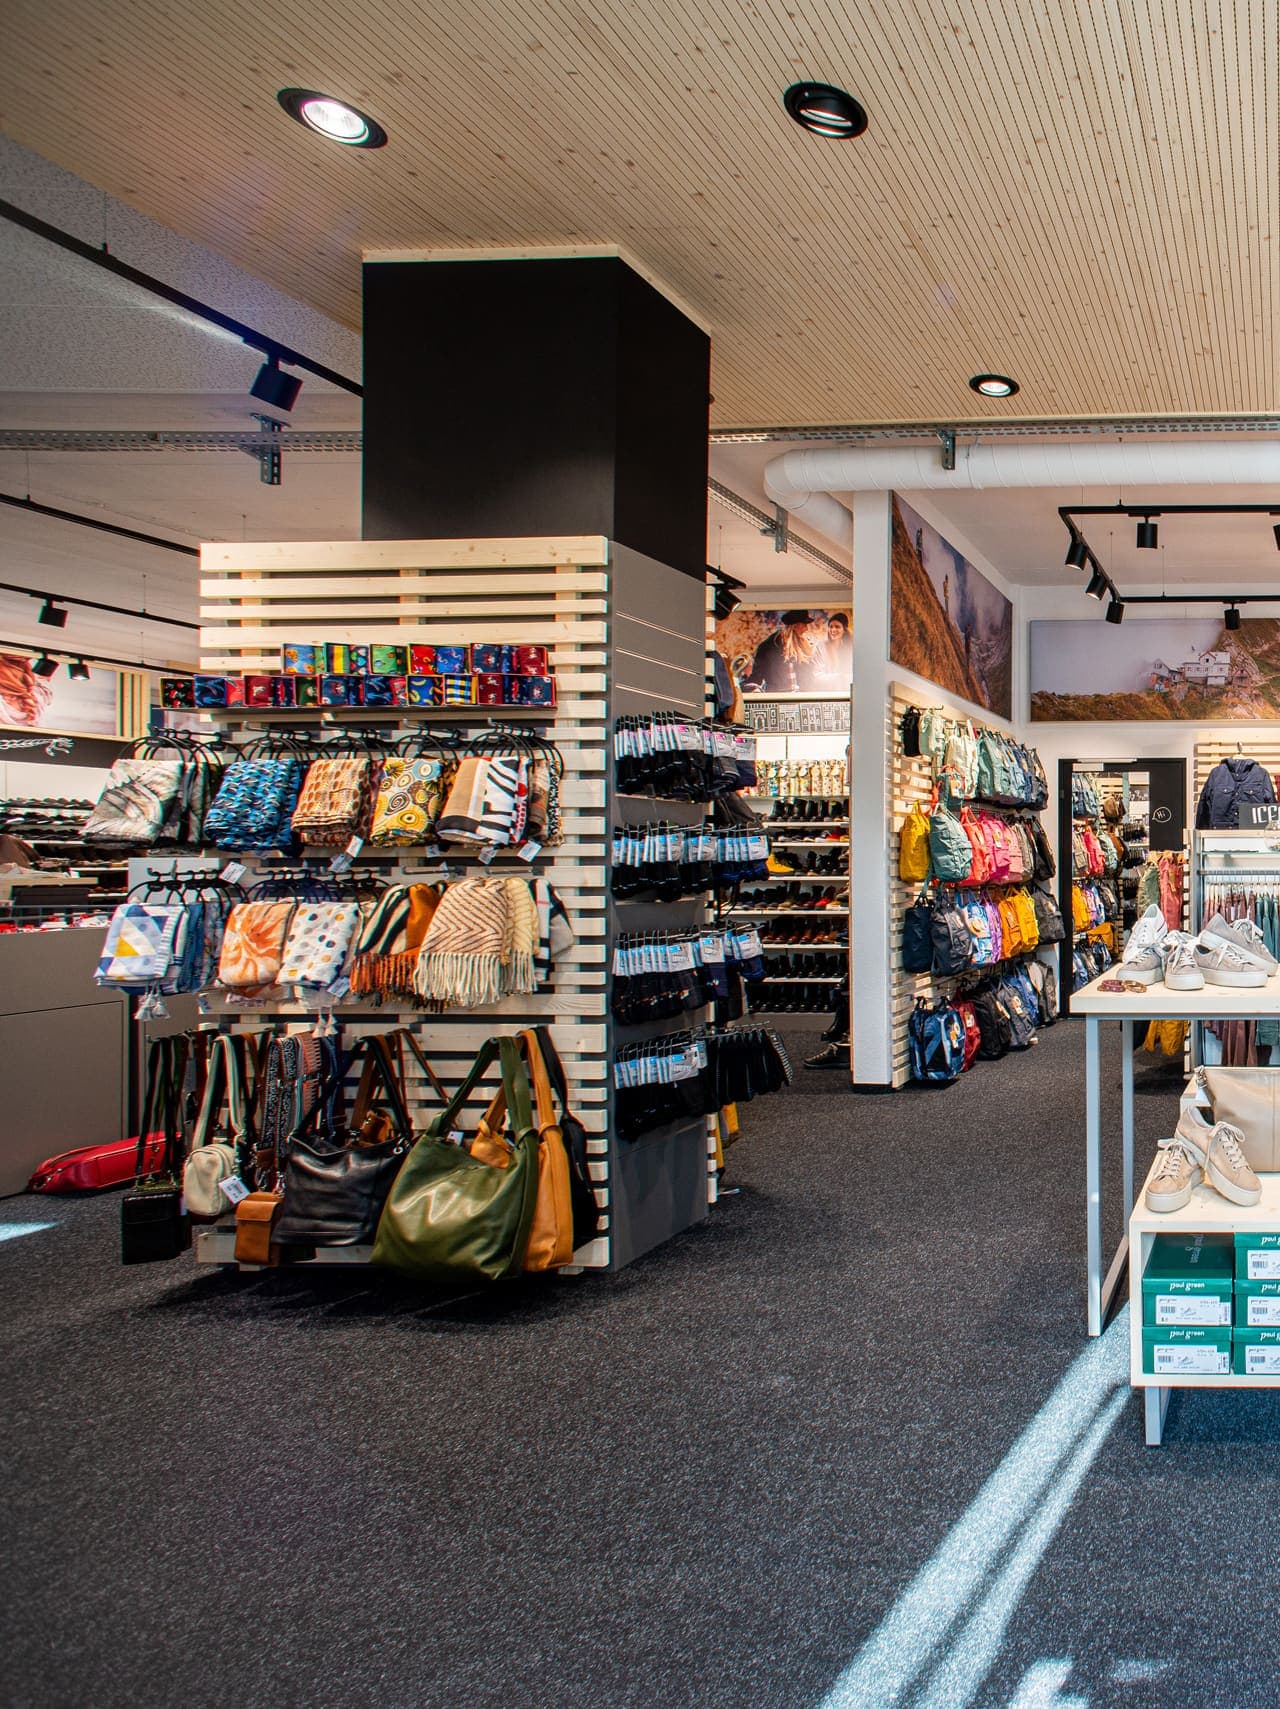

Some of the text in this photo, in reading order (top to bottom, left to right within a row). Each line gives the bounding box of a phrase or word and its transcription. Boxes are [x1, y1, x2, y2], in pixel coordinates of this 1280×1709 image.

[1261, 1236, 1276, 1245] paul
[1169, 1282, 1205, 1292] paul green
[1261, 1283, 1276, 1292] paul
[1169, 1330, 1205, 1340] paul green
[1260, 1331, 1275, 1341] paul
